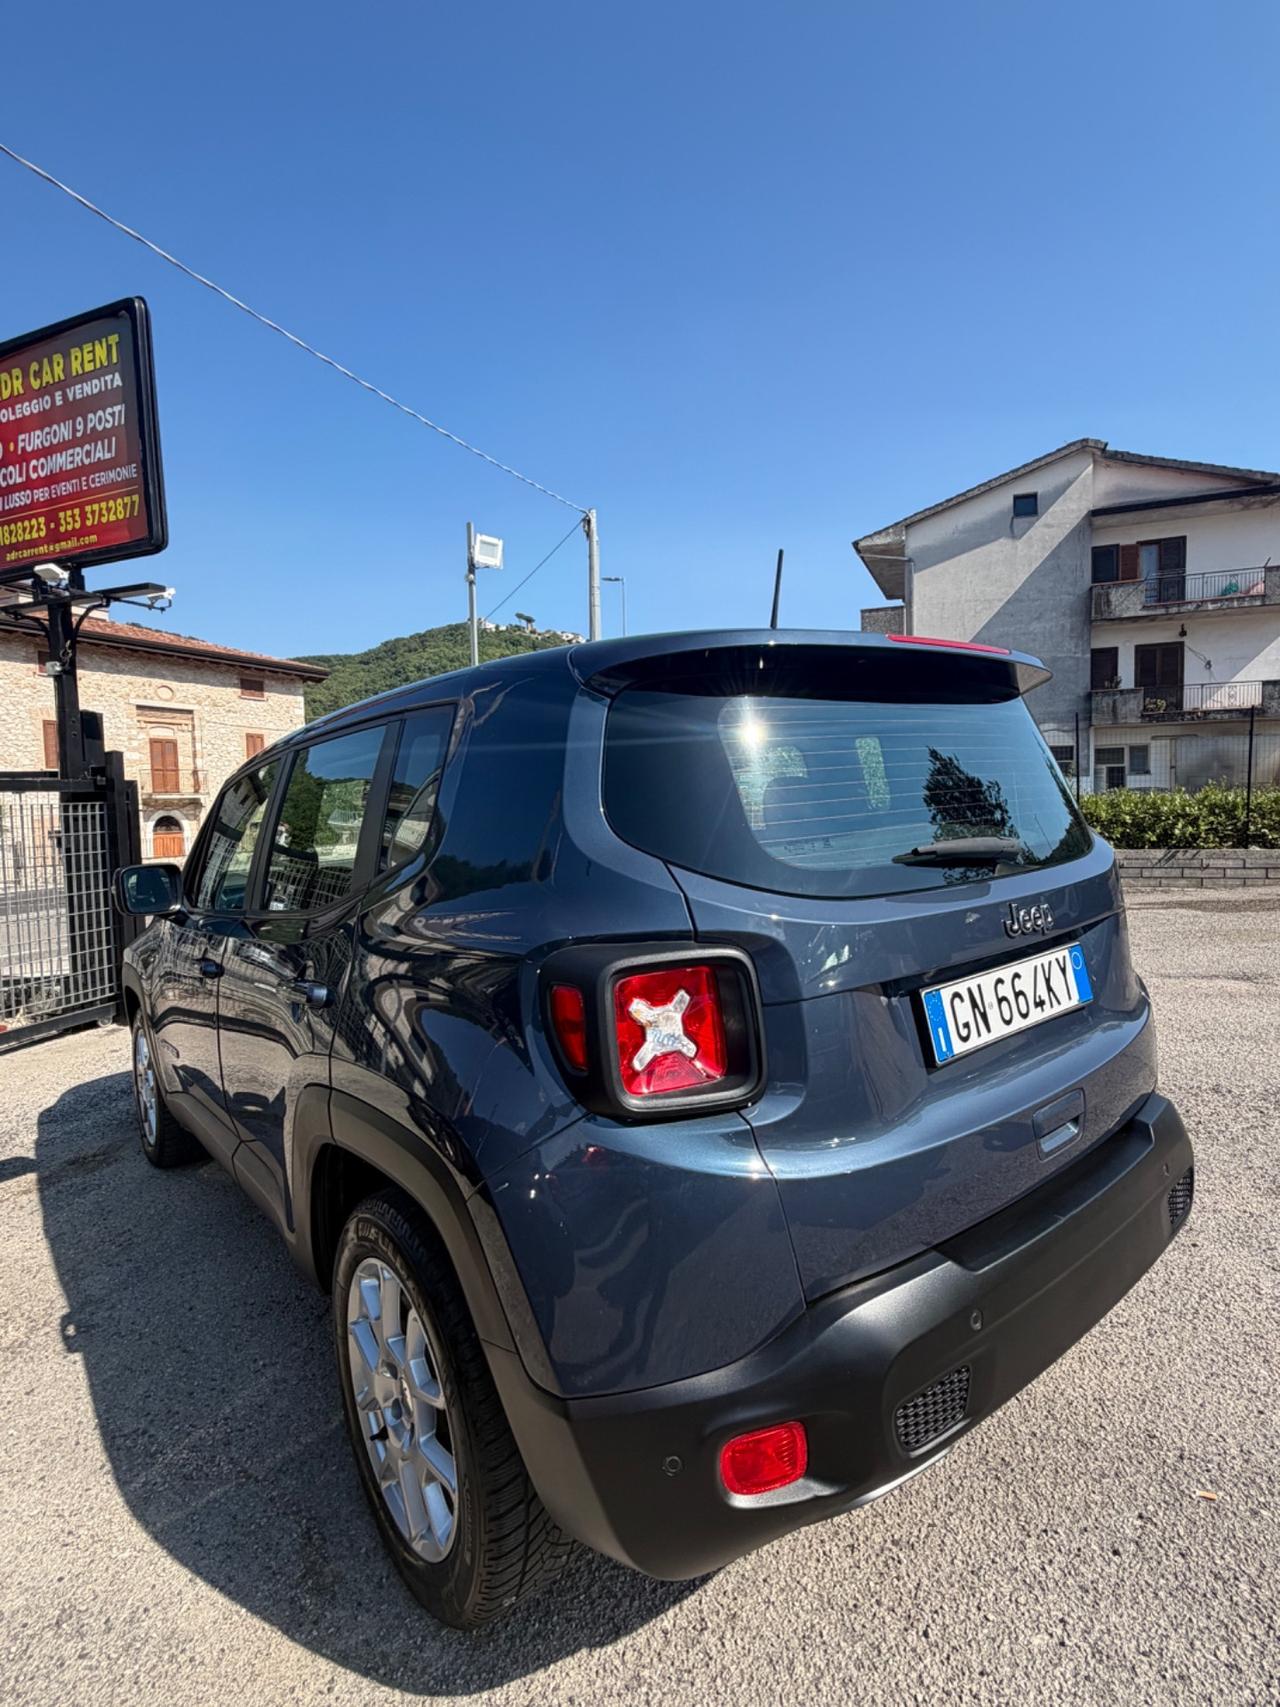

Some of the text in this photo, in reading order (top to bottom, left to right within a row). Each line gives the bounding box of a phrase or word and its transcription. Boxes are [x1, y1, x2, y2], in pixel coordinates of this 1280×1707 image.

[0, 333, 119, 401] DR CAR RENT
[54, 391, 63, 406] E
[66, 371, 123, 401] VENDITA
[18, 419, 72, 455] FURGONI
[76, 416, 84, 438] 9
[87, 404, 125, 434] POSTI
[0, 462, 26, 488] COLI
[29, 436, 116, 480] COMMERCIALI
[4, 490, 32, 510] LUSSO
[33, 484, 50, 503] PER
[51, 478, 81, 499] EVENTI
[82, 477, 88, 490] E
[89, 464, 138, 489] CERIMONIE
[58, 508, 81, 533] 353
[85, 494, 140, 527] 3732877
[1003, 903, 1056, 938] Jeep
[950, 983, 991, 1043] GN
[994, 955, 1072, 1026] 664KY
